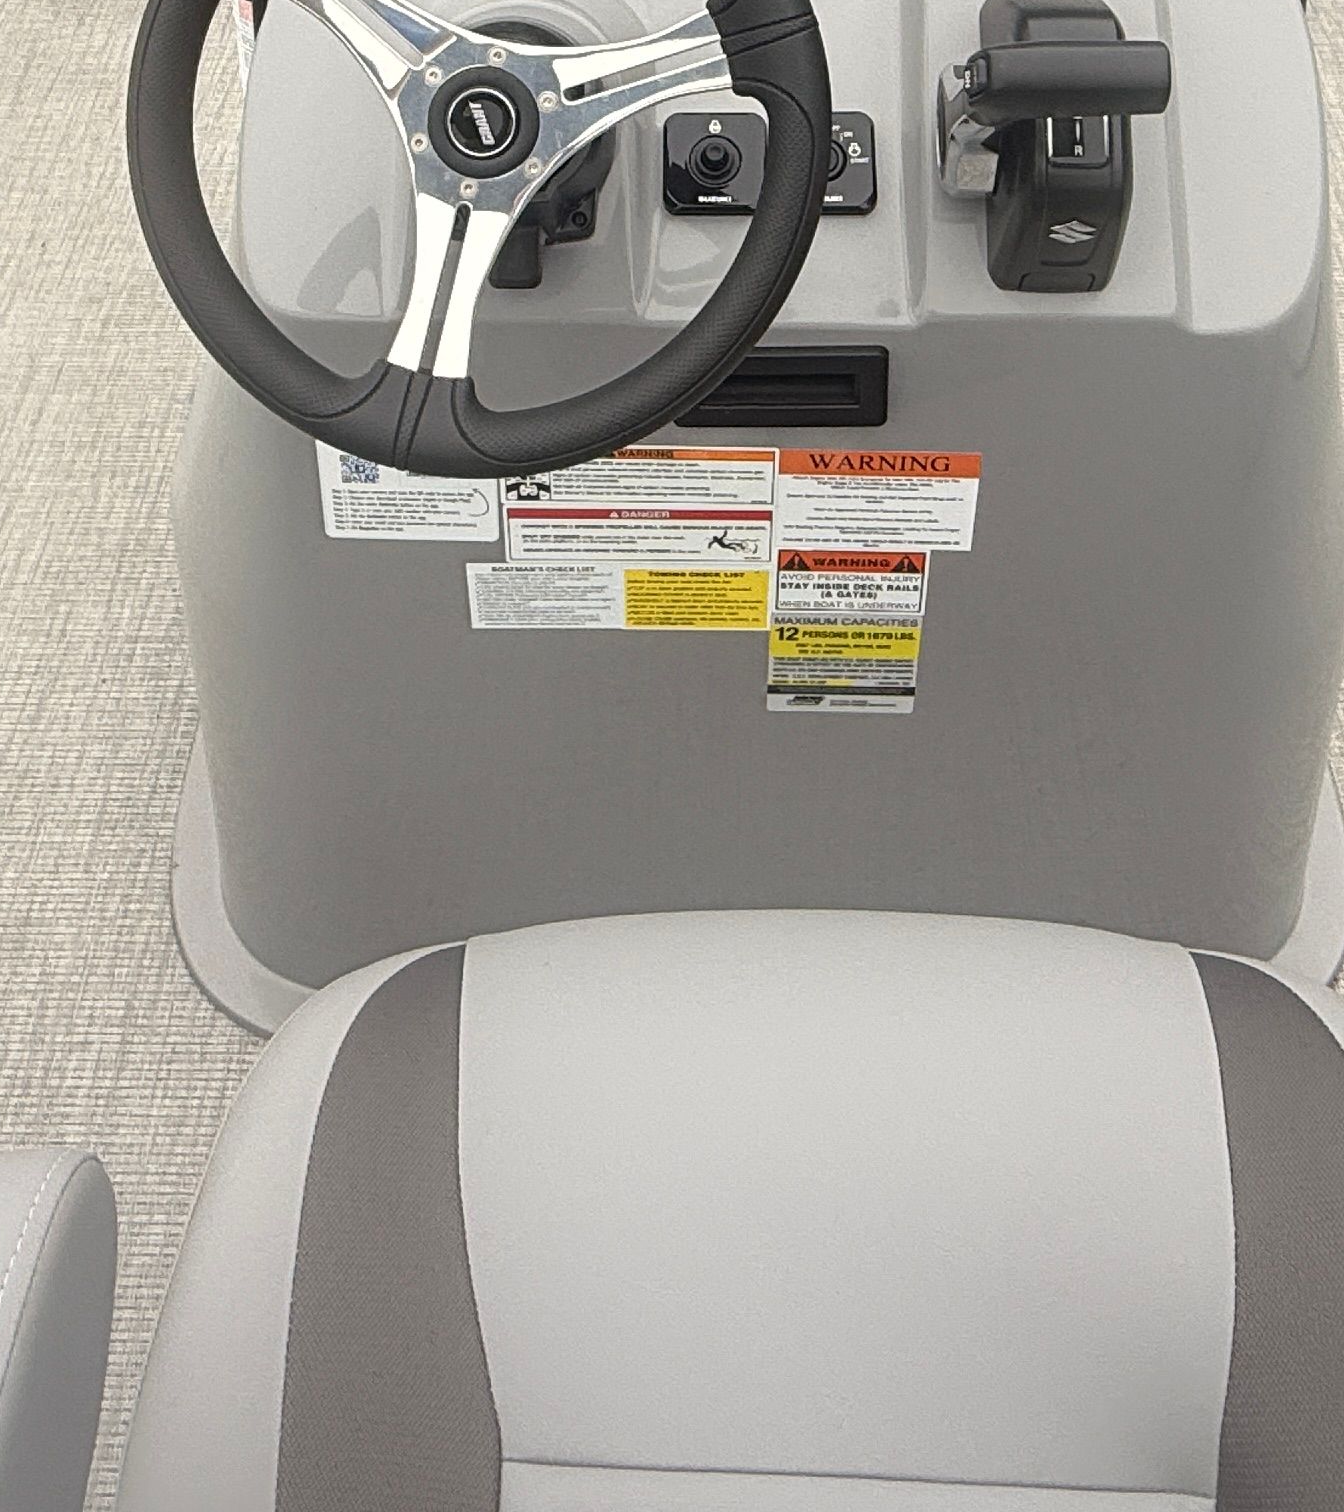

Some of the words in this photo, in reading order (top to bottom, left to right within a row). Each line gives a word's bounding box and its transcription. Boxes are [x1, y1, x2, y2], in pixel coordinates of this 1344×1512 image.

[616, 450, 674, 458] WARNING
[809, 453, 951, 472] WARNING
[621, 510, 670, 519] DANGER
[812, 557, 891, 568] WARNING
[817, 574, 876, 582] PERSONAL
[880, 575, 921, 583] INJURY
[853, 583, 884, 591] DECK
[886, 584, 920, 592] RAILS
[857, 601, 918, 609] UNDERWAY
[774, 617, 838, 625] MAXIMUM
[840, 618, 918, 627] CAPACITIES
[775, 626, 800, 641] 12
[802, 631, 849, 639] PERSONS
[850, 631, 866, 640] OR
[894, 632, 918, 641] LBS.
